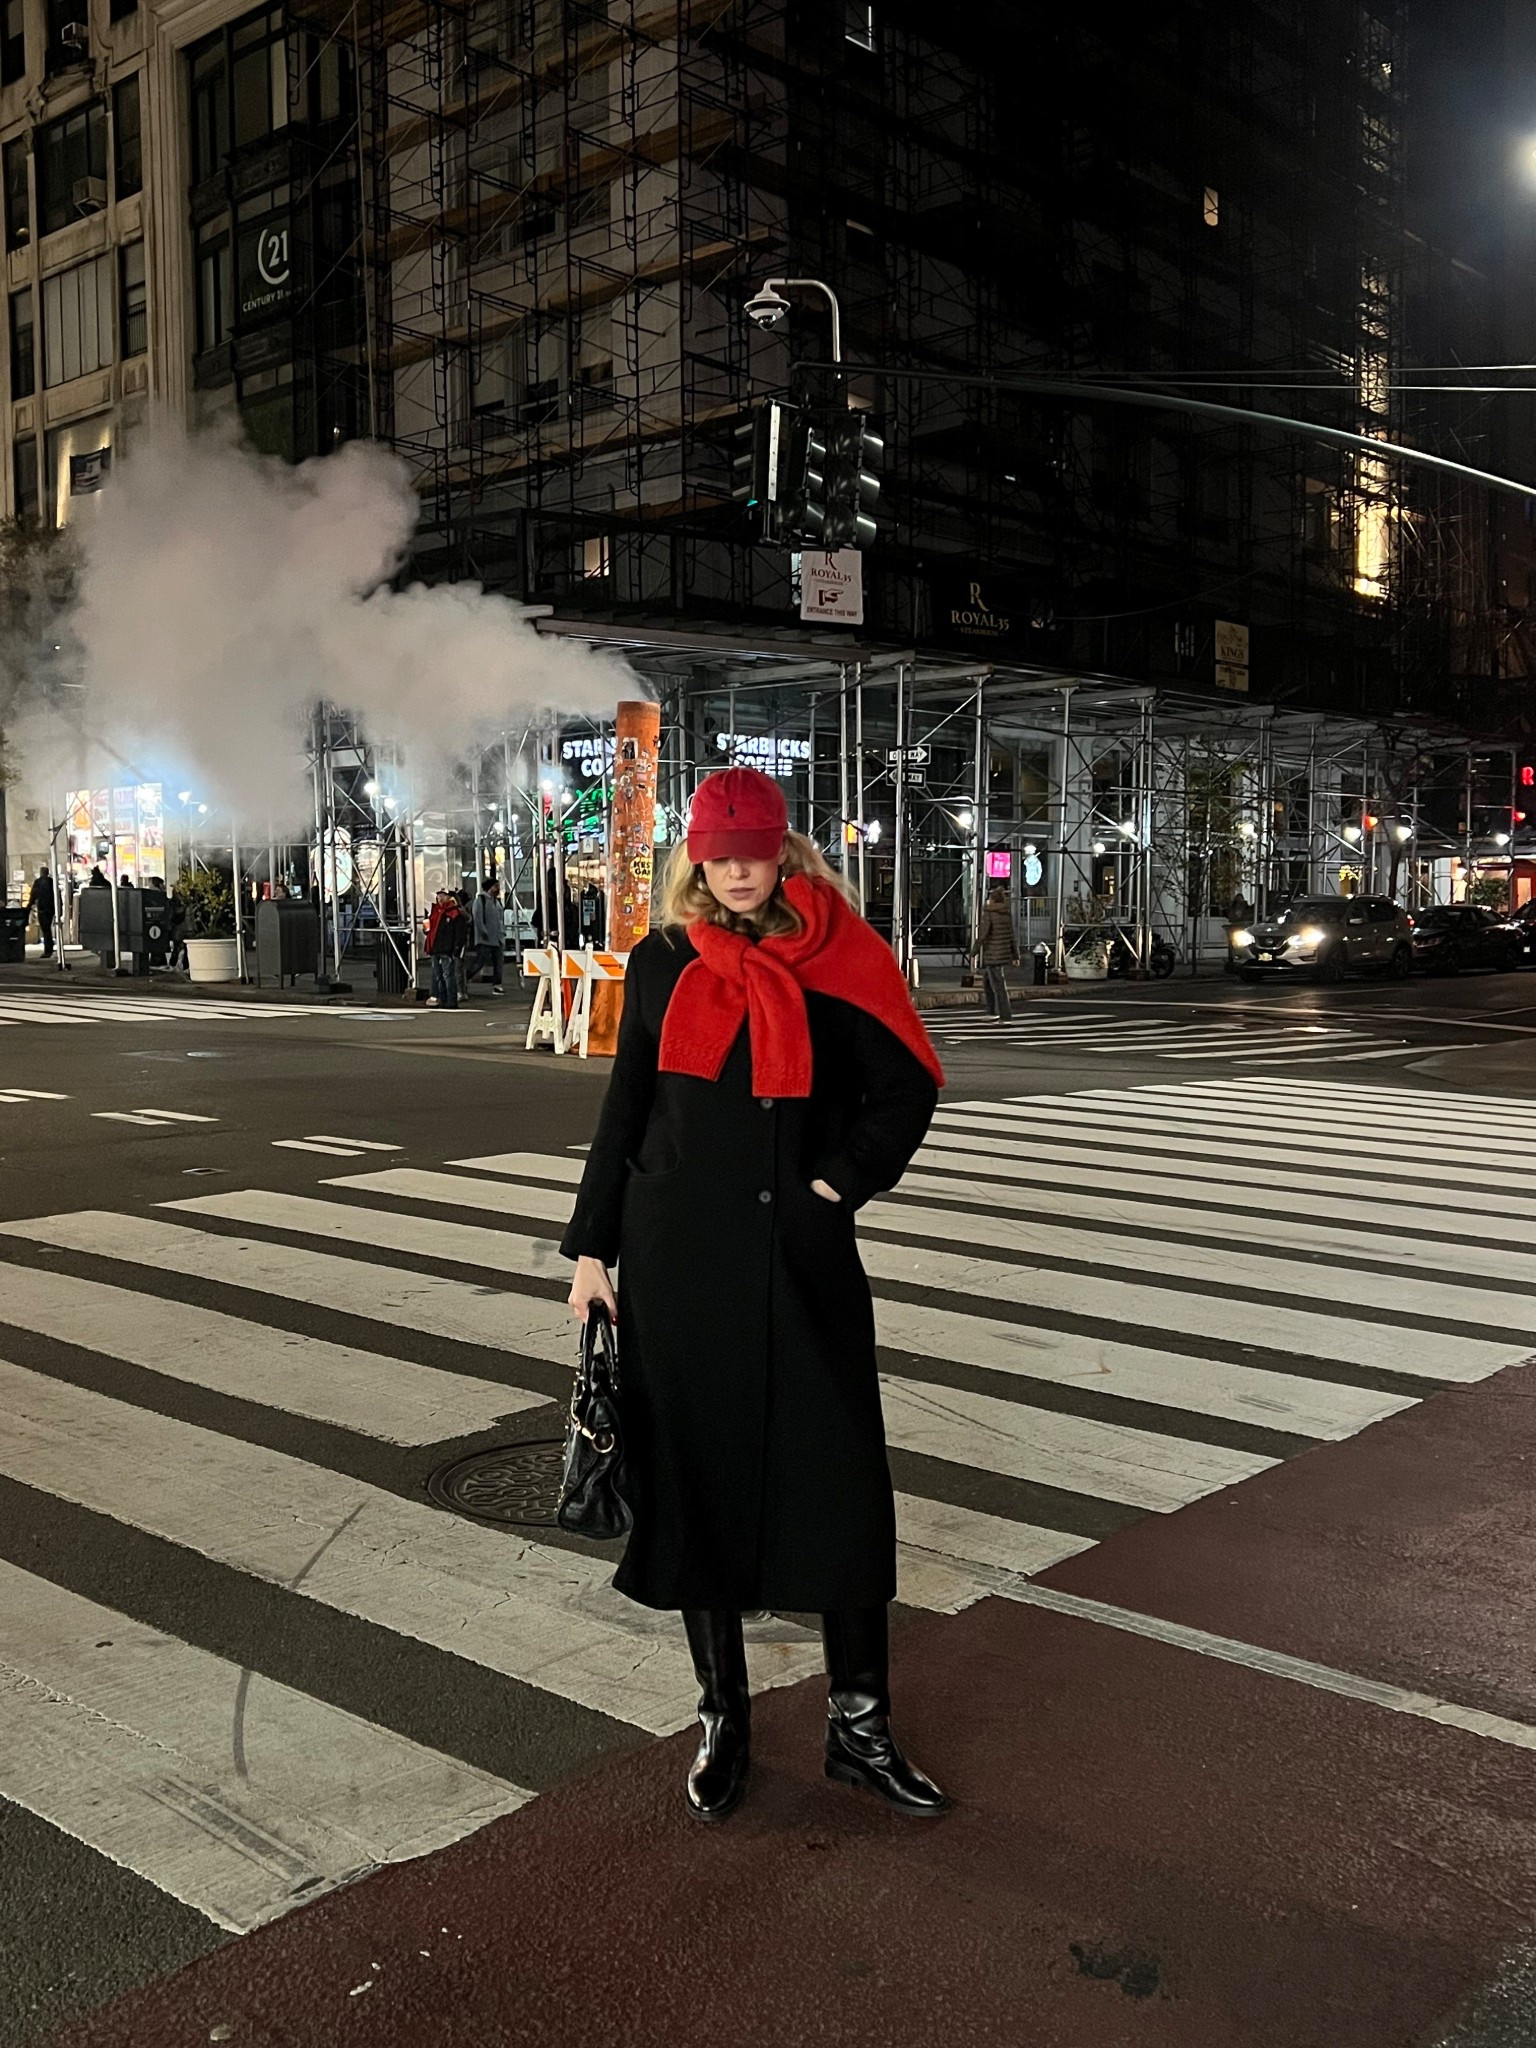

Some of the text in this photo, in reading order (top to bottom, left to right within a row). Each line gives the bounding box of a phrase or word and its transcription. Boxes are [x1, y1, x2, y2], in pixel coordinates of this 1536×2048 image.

[242, 291, 276, 312] CENTURY
[825, 551, 838, 570] R
[969, 582, 990, 612] R
[806, 606, 833, 616] ENTRANCE
[834, 609, 846, 617] THIS
[950, 609, 1010, 631] ROYAL35
